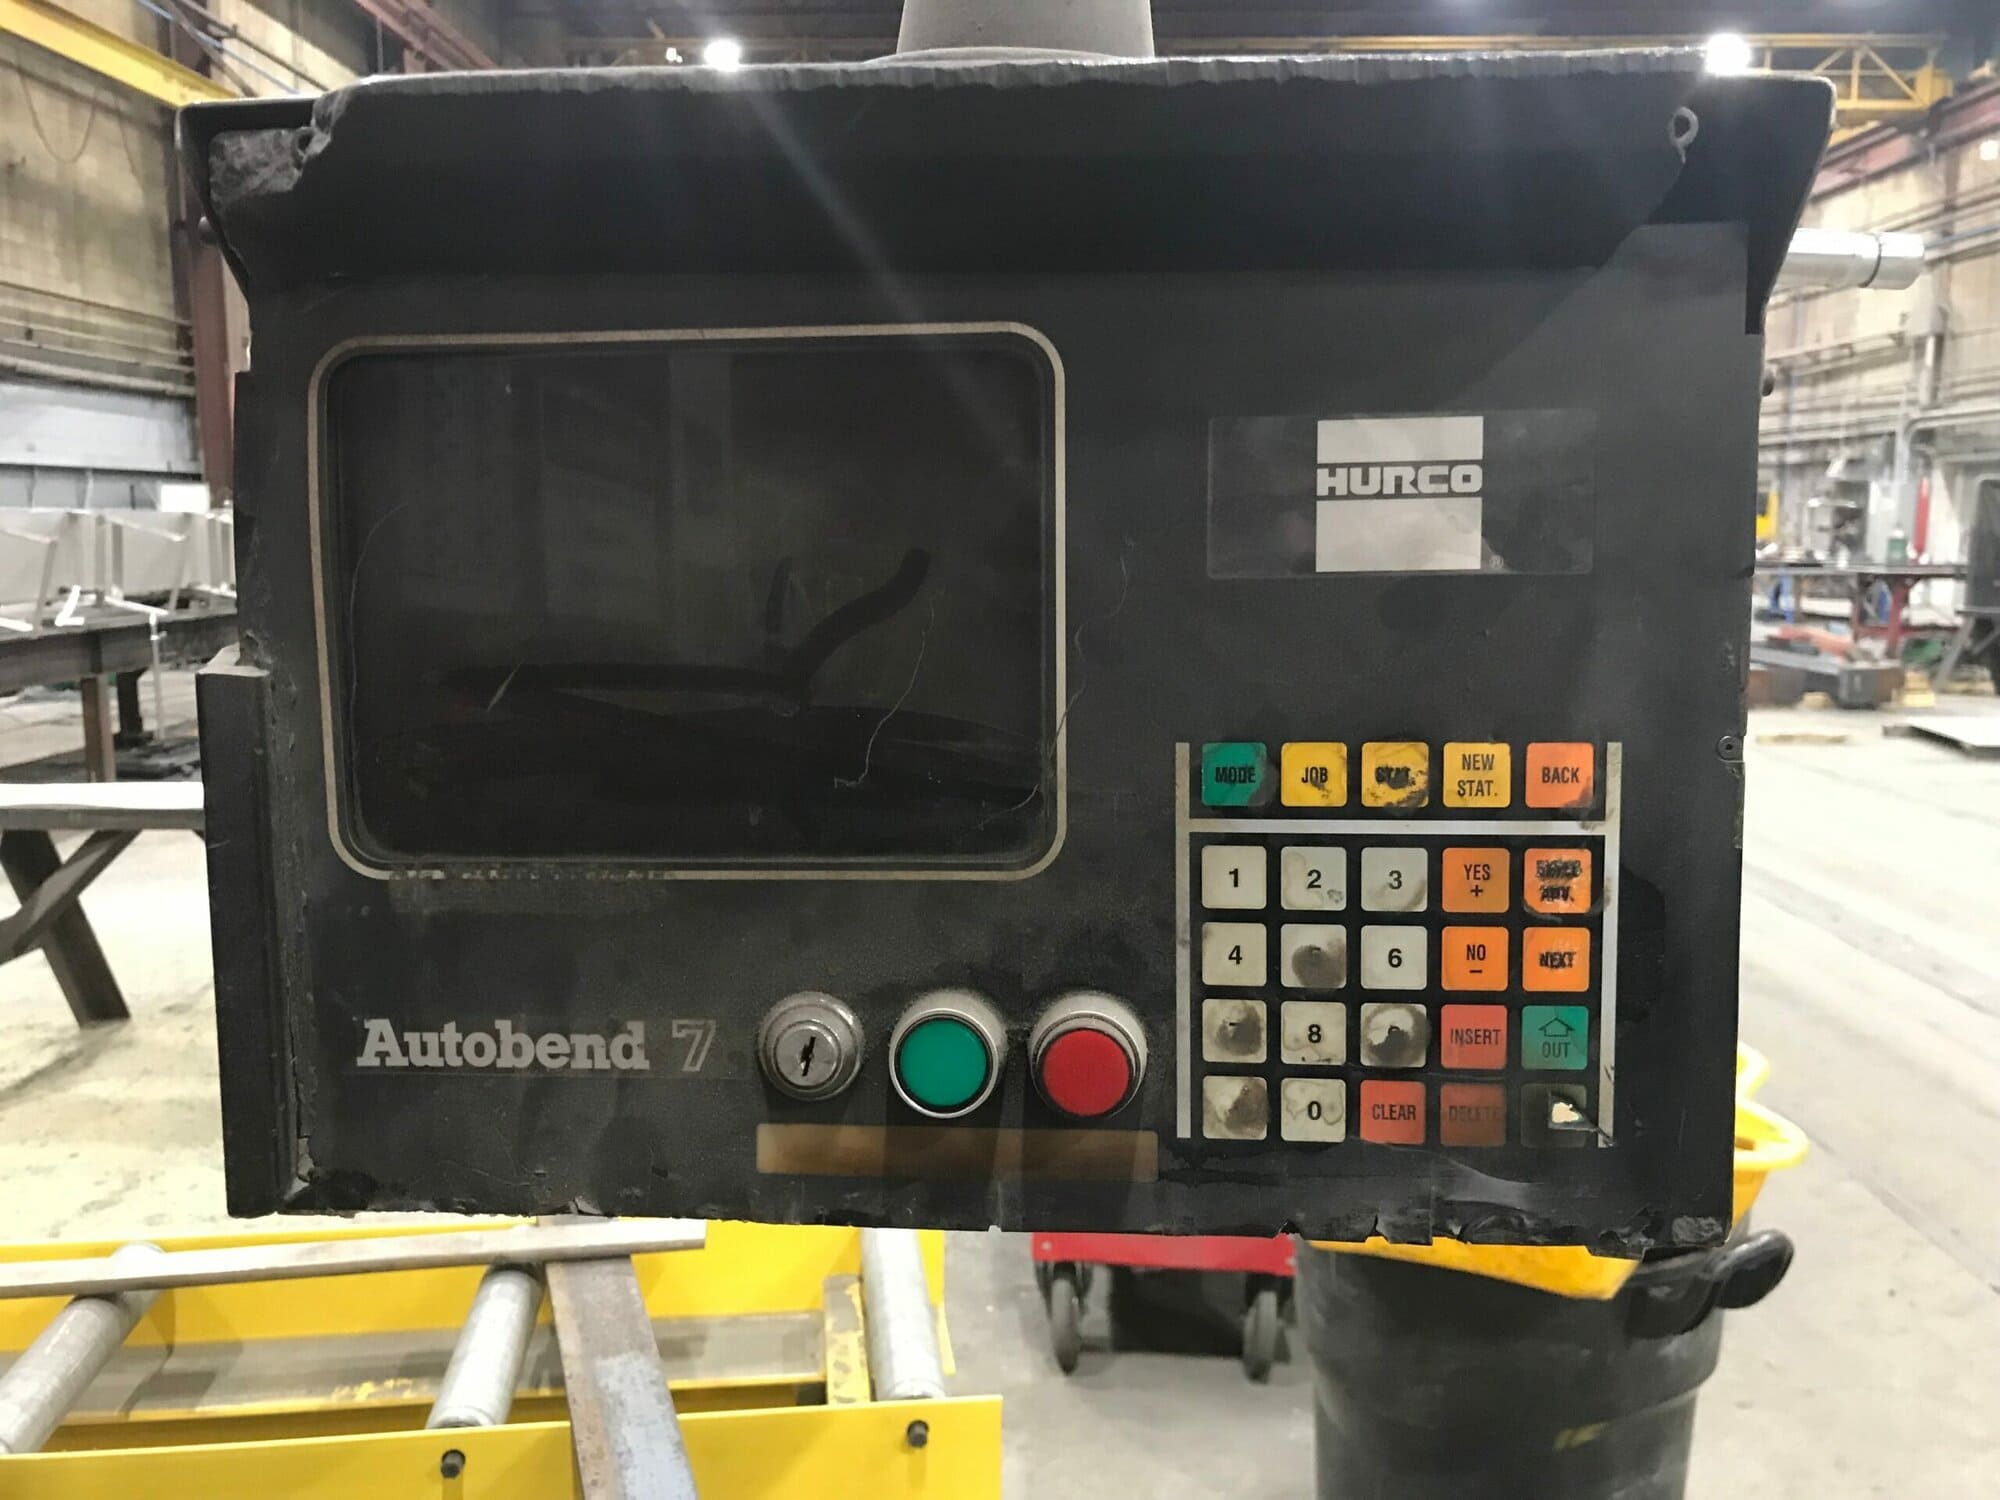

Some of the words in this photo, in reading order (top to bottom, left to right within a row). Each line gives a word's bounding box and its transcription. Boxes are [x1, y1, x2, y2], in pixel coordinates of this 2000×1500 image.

[1316, 464, 1483, 496] HURCO
[1461, 753, 1495, 771] NEW
[1215, 766, 1256, 784] MODE
[1301, 767, 1328, 784] JOB
[1541, 766, 1580, 784] BACK
[1457, 780, 1499, 797] STAT.
[1228, 868, 1239, 888] 1
[1307, 869, 1322, 889] 2
[1388, 871, 1403, 890] 3
[1464, 864, 1491, 881] YES
[1228, 945, 1242, 965] 4
[1388, 948, 1402, 967] 6
[1466, 944, 1486, 961] NO
[1308, 1024, 1321, 1043] 8
[1449, 1028, 1500, 1046] INSERT
[356, 1018, 650, 1070] Autobend
[671, 1019, 717, 1072] 7
[1541, 1042, 1570, 1058] OUT
[1308, 1101, 1321, 1120] 0
[1372, 1104, 1416, 1121] CLEAR
